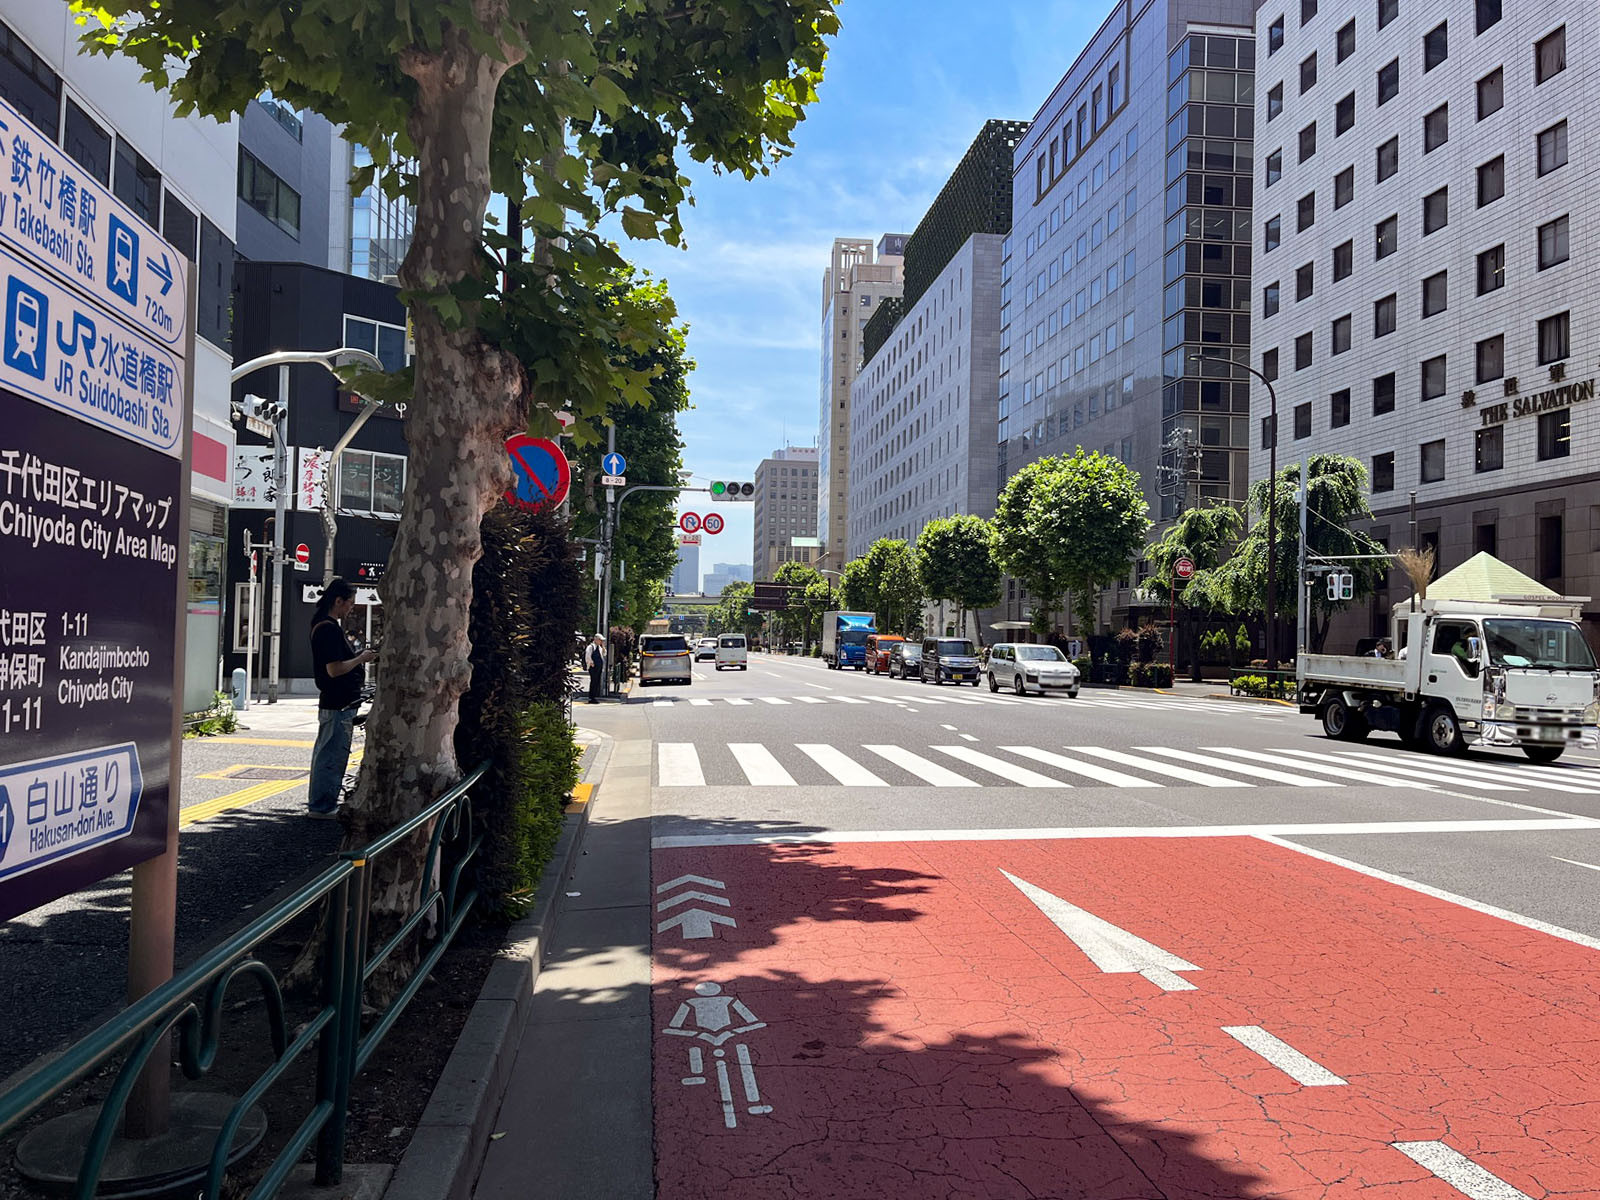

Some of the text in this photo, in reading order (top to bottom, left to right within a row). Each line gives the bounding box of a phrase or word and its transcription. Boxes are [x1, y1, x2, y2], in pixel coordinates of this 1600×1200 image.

[13, 192, 73, 266] Takebashi
[76, 239, 95, 282] Sta.
[145, 295, 172, 333] 720m
[54, 359, 171, 440] JR Suidobashi Sta.
[1480, 378, 1595, 426] THE SALVATION
[0, 450, 172, 530] 千代田区エリアマップ
[350, 470, 392, 482] ラーメン
[0, 500, 176, 569] Chiyoda City Area Map
[707, 518, 720, 529] 50
[61, 612, 88, 637] 1-11
[60, 646, 149, 675] Kandajimbocho
[58, 676, 133, 708] Chiyoda City
[2, 696, 42, 733] 1-11
[27, 760, 119, 825] 白山通り
[29, 809, 115, 853] Hakusan-dori Ave.
